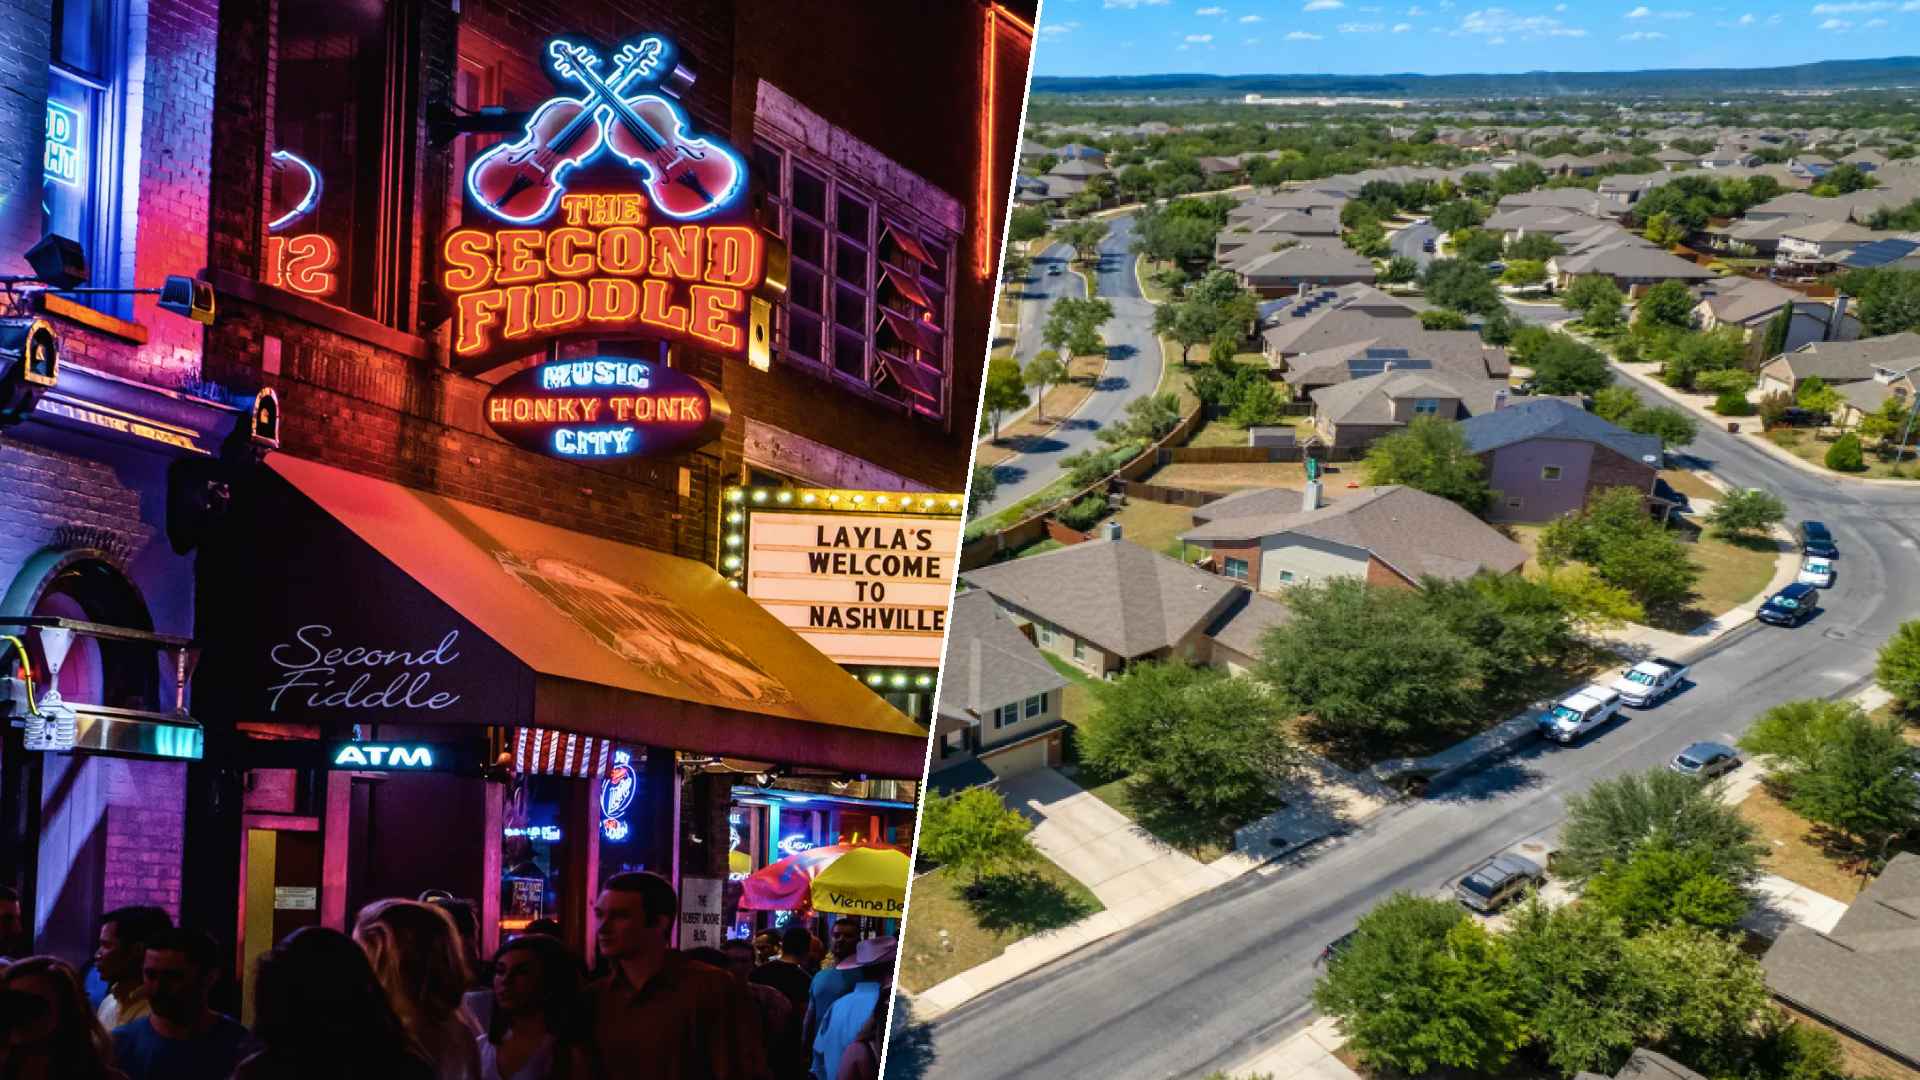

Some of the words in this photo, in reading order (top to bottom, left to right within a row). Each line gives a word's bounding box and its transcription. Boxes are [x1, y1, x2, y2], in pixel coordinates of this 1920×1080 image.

[561, 194, 642, 225] THE
[444, 225, 763, 290] SECOND
[456, 278, 745, 353] FIDDLE
[544, 361, 650, 389] MUSIC
[489, 397, 599, 422] HONKY
[610, 396, 703, 421] TONK
[555, 427, 634, 455] CITY
[816, 525, 932, 550] LAYLA'S
[808, 552, 941, 578] WELCOME
[855, 581, 885, 601] TO
[809, 606, 945, 631] NASHVILLE
[270, 624, 460, 668] Second
[267, 667, 460, 711] Fiddle
[335, 746, 433, 767] ATM
[830, 892, 883, 911] Vienna
